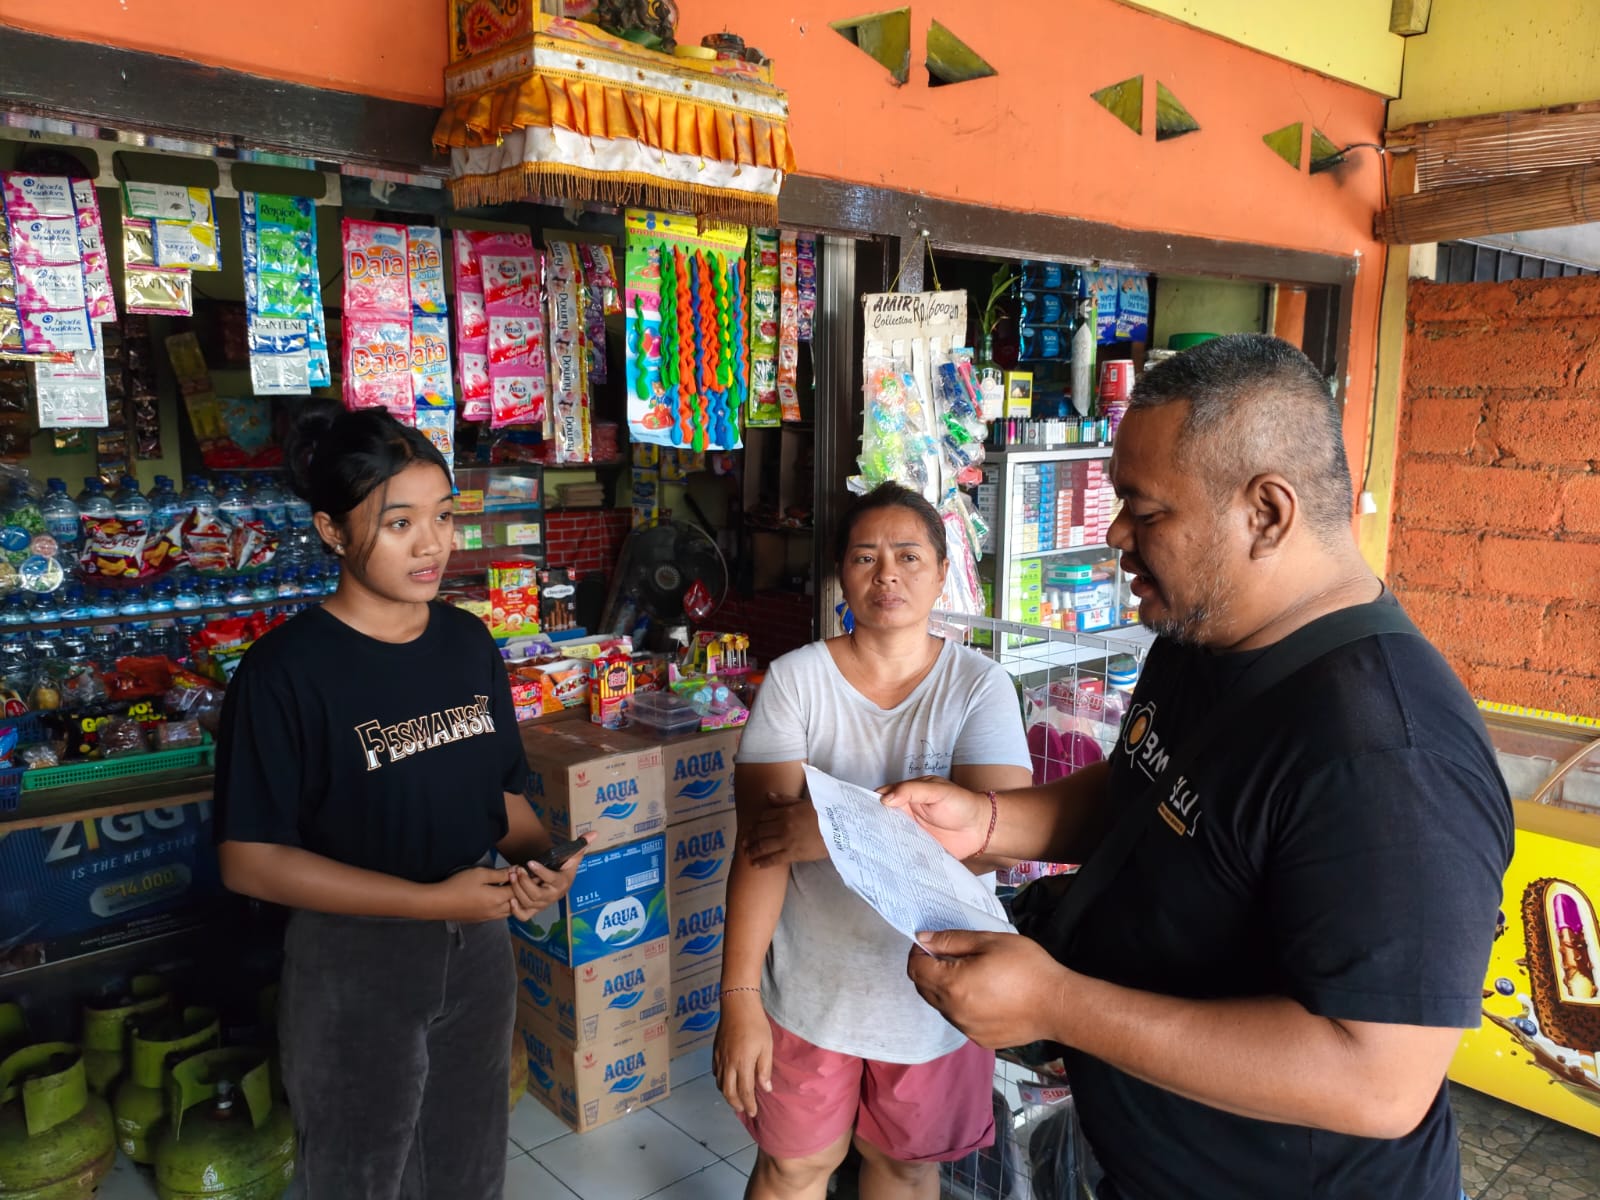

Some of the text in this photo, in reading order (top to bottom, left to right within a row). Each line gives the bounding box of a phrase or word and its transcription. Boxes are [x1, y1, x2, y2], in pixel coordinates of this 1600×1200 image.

[349, 248, 406, 280] Daia
[409, 243, 440, 271] aia
[557, 292, 569, 332] Downy
[873, 295, 913, 312] AMIR
[873, 314, 913, 329] Collection
[352, 345, 410, 378] Daia
[410, 338, 448, 367] aia
[562, 355, 572, 392] Downy
[565, 416, 575, 452] Downy
[673, 750, 726, 781] AQUA
[595, 778, 640, 804] AQUA
[71, 834, 197, 881] IS THE NEW STYLE
[673, 830, 726, 863] AQUA
[602, 907, 640, 930] AQUA
[674, 904, 726, 941] AQUA
[602, 967, 646, 998] AQUA
[603, 1051, 646, 1083] AQUA
